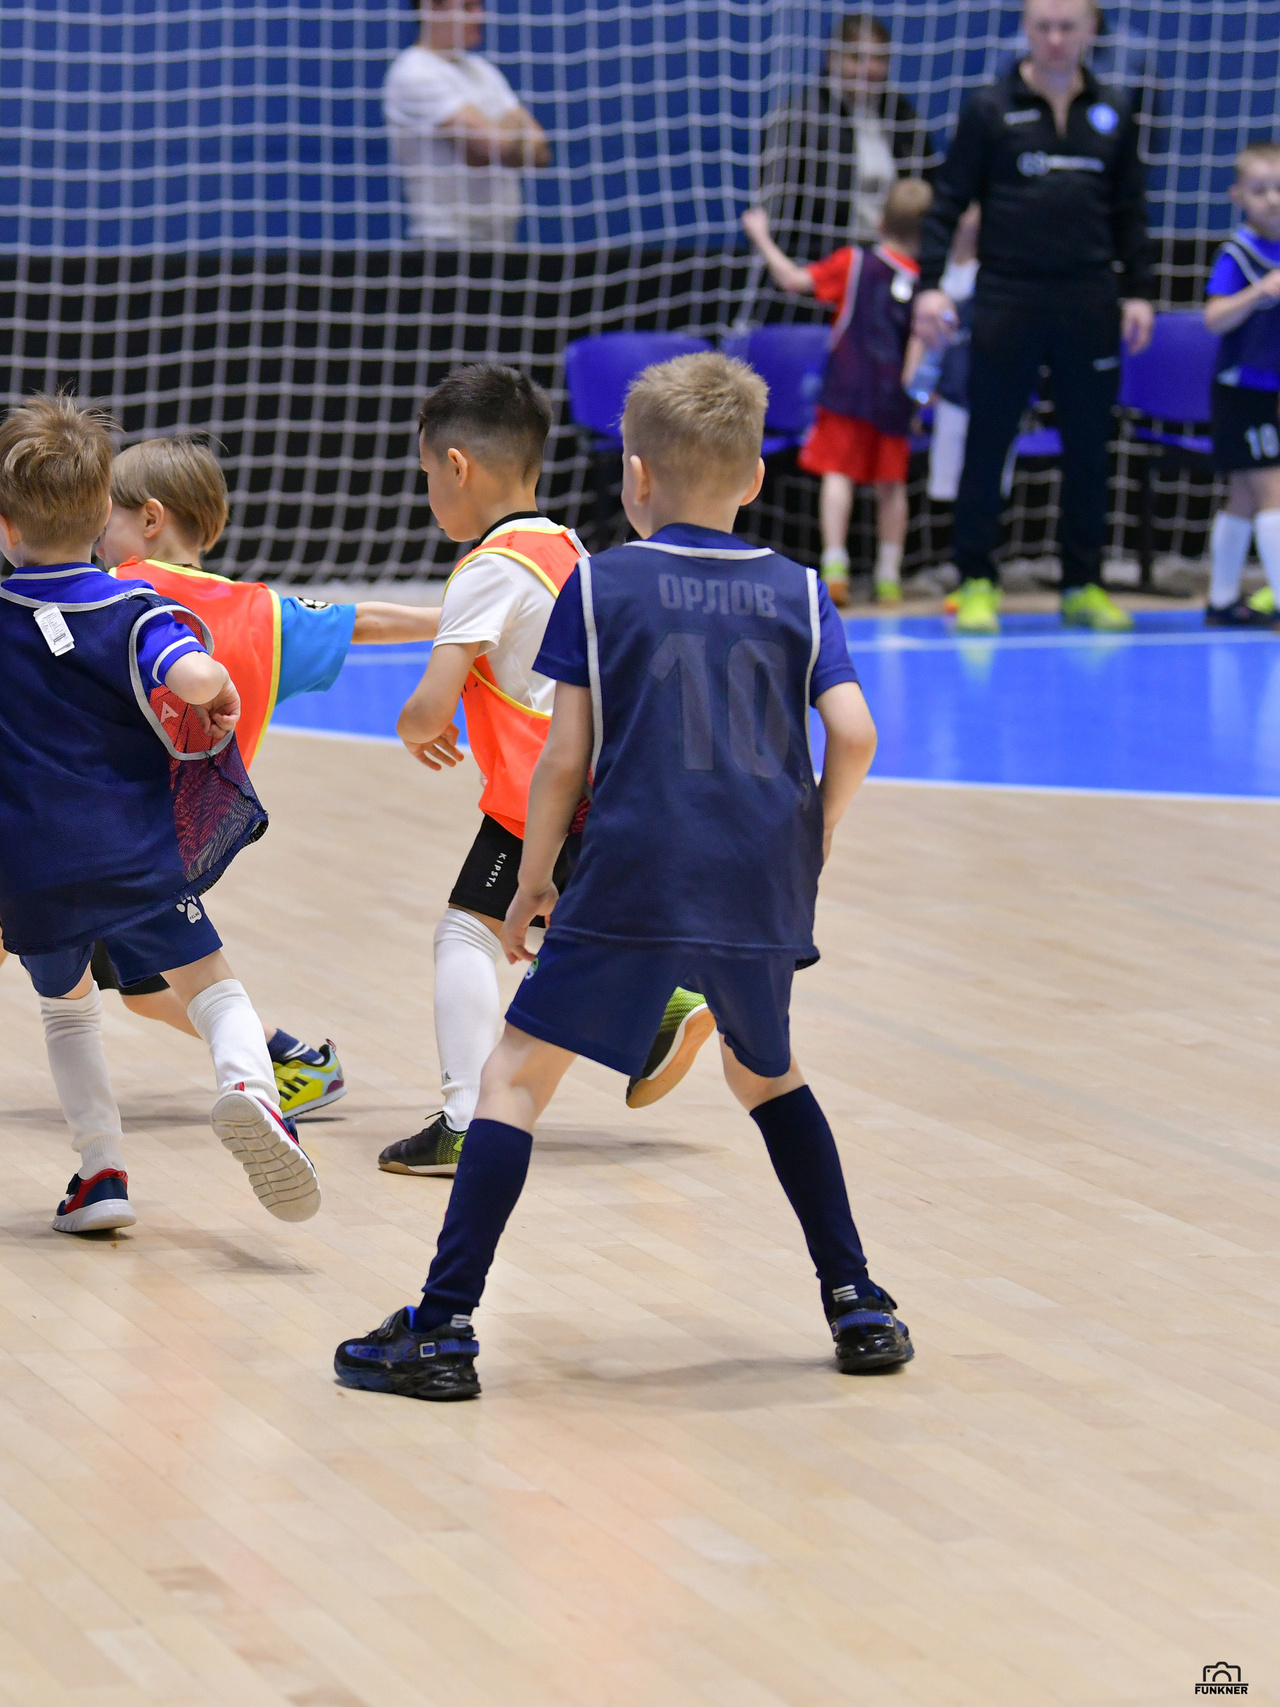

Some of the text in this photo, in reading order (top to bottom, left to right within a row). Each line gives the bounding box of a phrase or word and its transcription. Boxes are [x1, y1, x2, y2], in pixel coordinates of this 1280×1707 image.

[658, 573, 778, 619] ОРЛОВ
[648, 631, 790, 779] 10
[485, 852, 507, 888] KIPSTA
